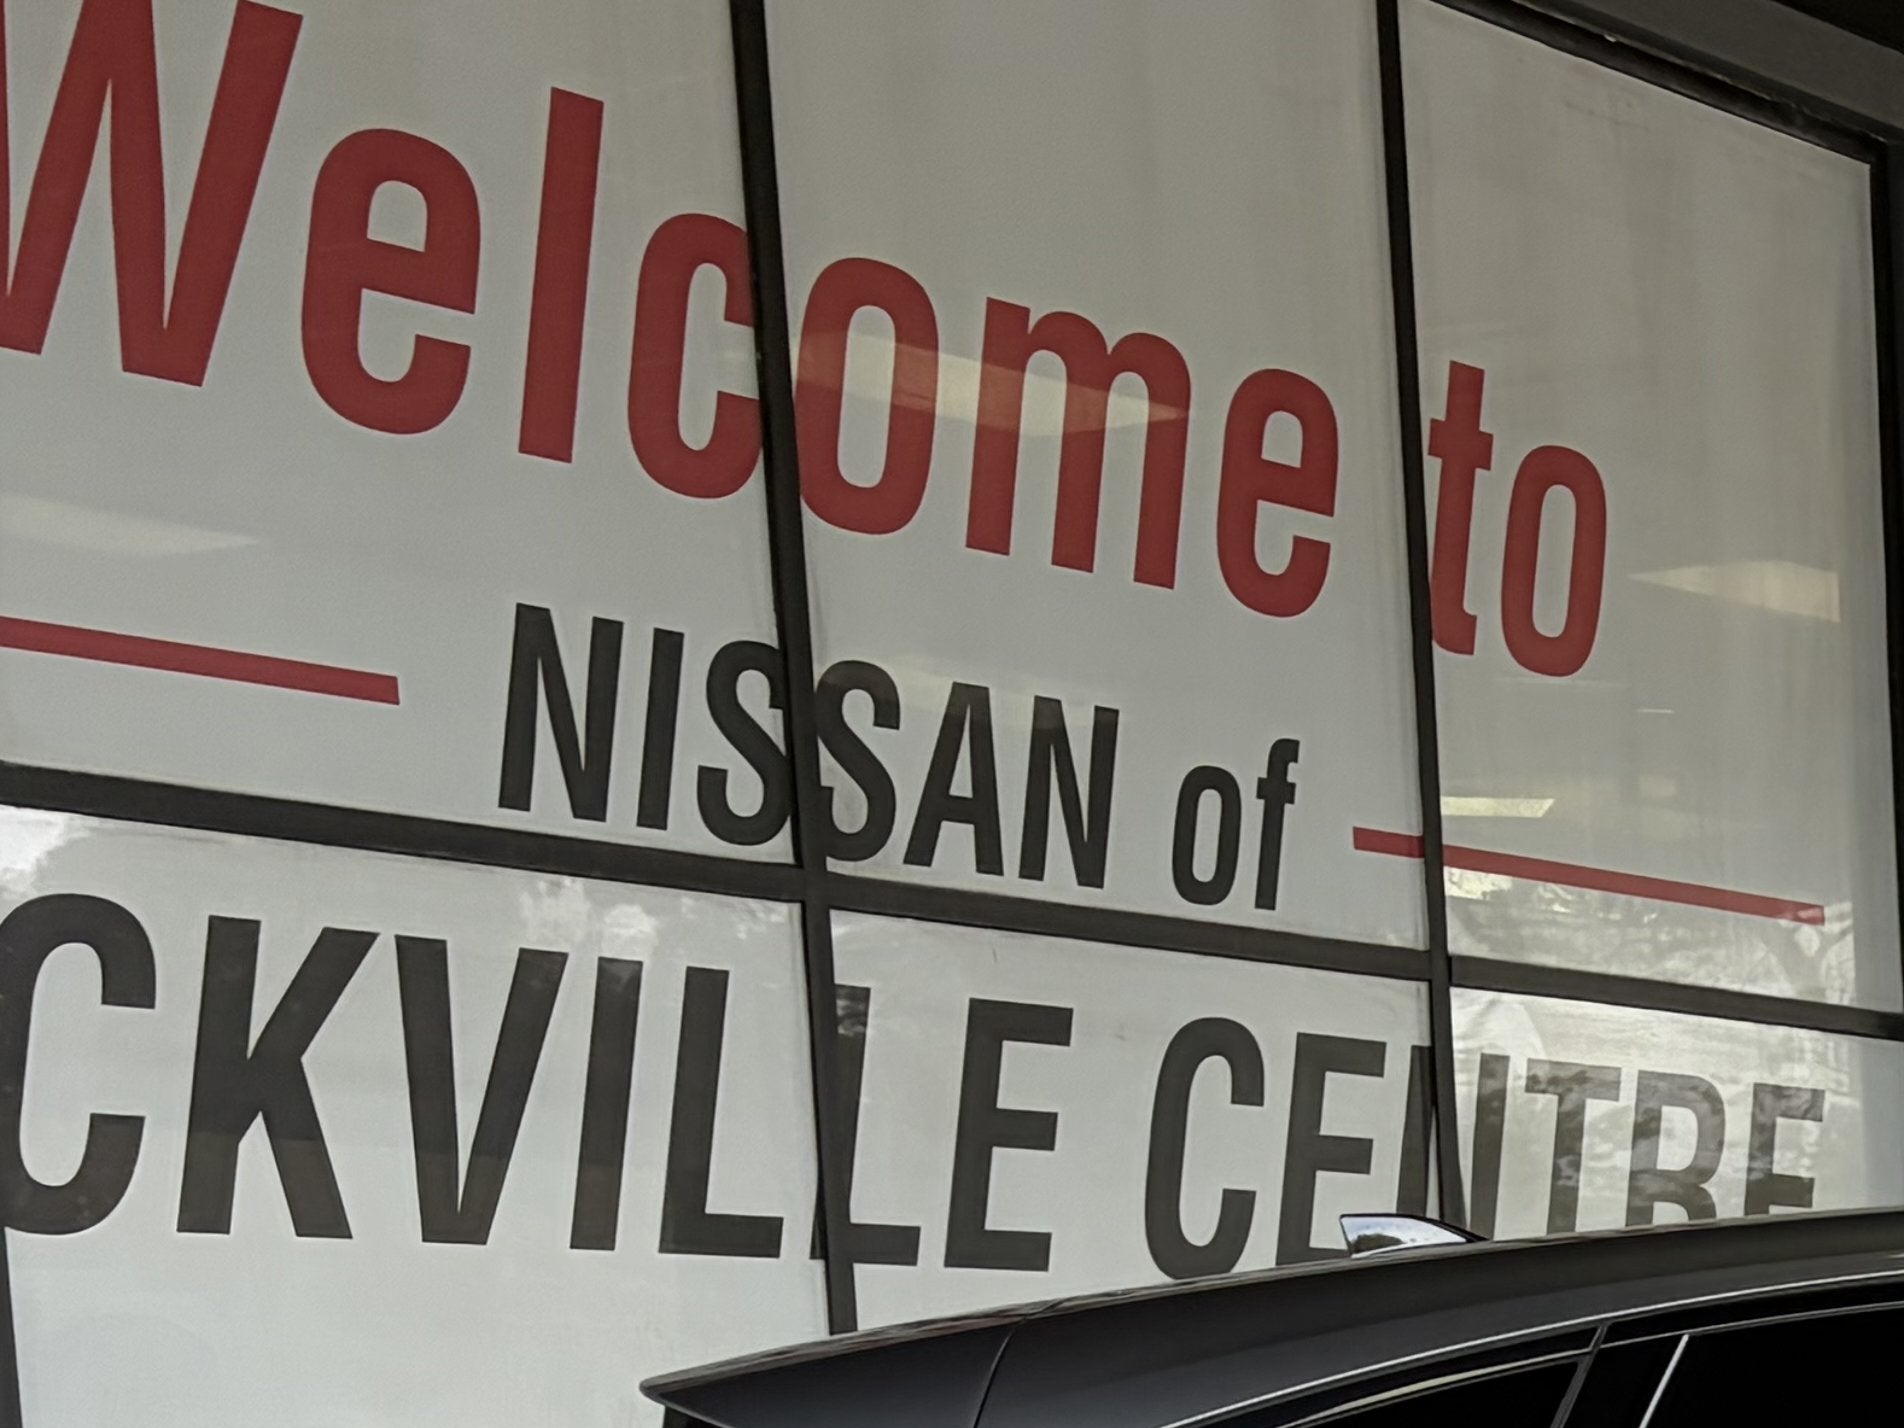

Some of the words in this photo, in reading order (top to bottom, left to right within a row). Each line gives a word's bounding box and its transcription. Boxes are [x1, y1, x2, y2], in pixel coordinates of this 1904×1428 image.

[0, 0, 1340, 618] Welcome
[1430, 360, 1608, 678] to
[498, 602, 1121, 889] NISSAN
[1170, 738, 1300, 911] of
[0, 893, 1074, 1271] CKVILLE
